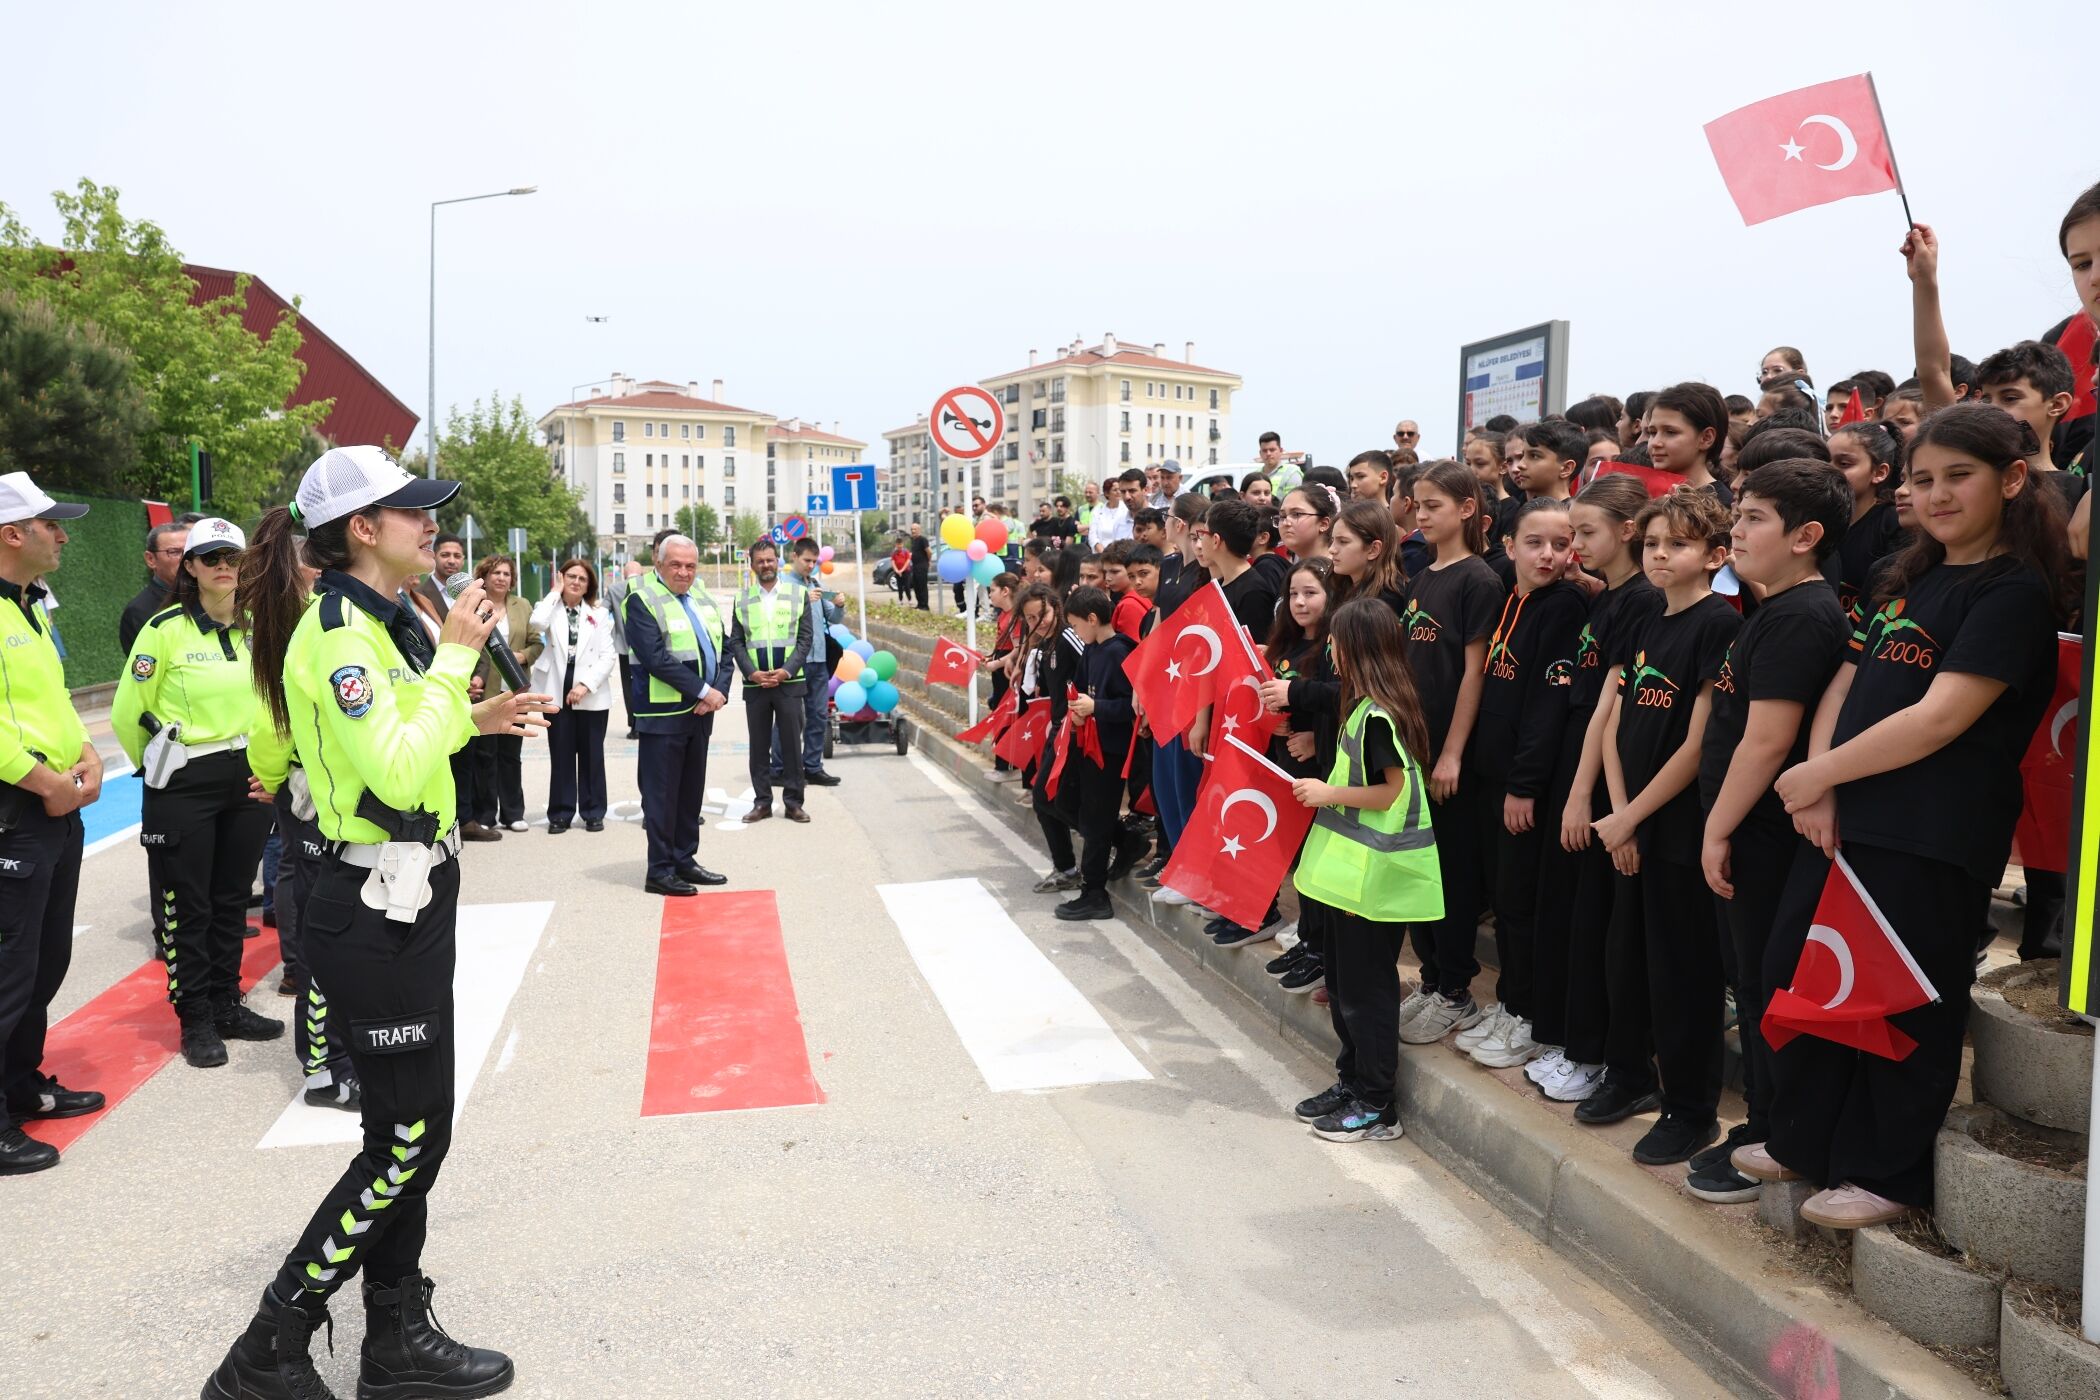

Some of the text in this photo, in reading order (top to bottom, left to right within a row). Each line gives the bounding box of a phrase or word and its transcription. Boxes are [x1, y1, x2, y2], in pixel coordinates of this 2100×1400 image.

[1410, 626, 1436, 642] 2006
[1581, 651, 1599, 668] 20
[1877, 640, 1934, 669] 2006
[1492, 660, 1515, 680] 2006
[1637, 687, 1674, 708] 2006
[368, 1023, 427, 1047] TRAFİK
